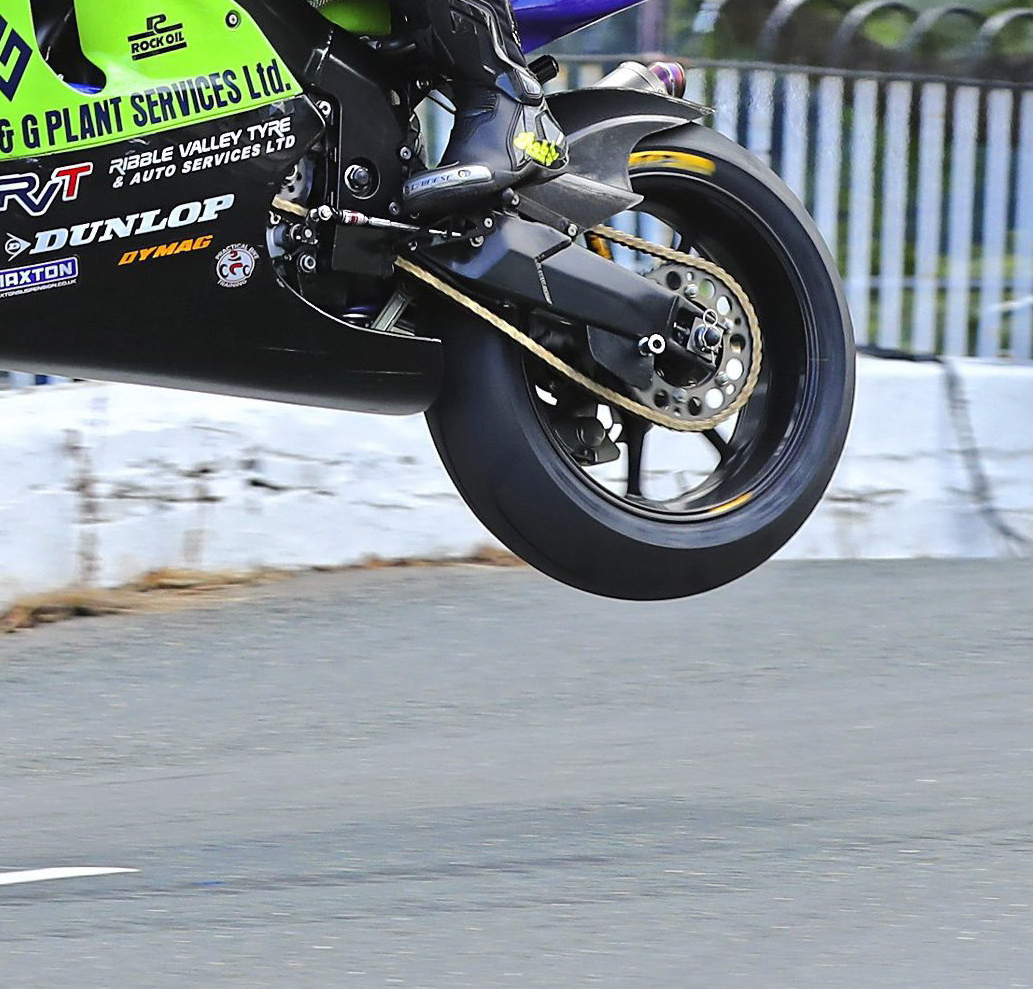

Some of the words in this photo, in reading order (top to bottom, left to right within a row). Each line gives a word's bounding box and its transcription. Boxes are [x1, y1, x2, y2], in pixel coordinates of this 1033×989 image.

[131, 37, 164, 55] ROCK
[165, 31, 185, 47] OIL
[22, 110, 41, 150] G
[46, 98, 124, 146] PLANT
[133, 69, 241, 127] SERVICES
[243, 59, 292, 98] Ltd.
[109, 146, 174, 176] RIBBLE
[178, 127, 243, 159] VALLEY
[246, 116, 292, 142] TYRE
[112, 176, 124, 189] &
[130, 164, 178, 185] AUTO
[181, 146, 262, 174] SERVICES
[266, 134, 296, 155] LTD
[28, 194, 235, 256] DUNLOP
[118, 235, 214, 267] DYMAG
